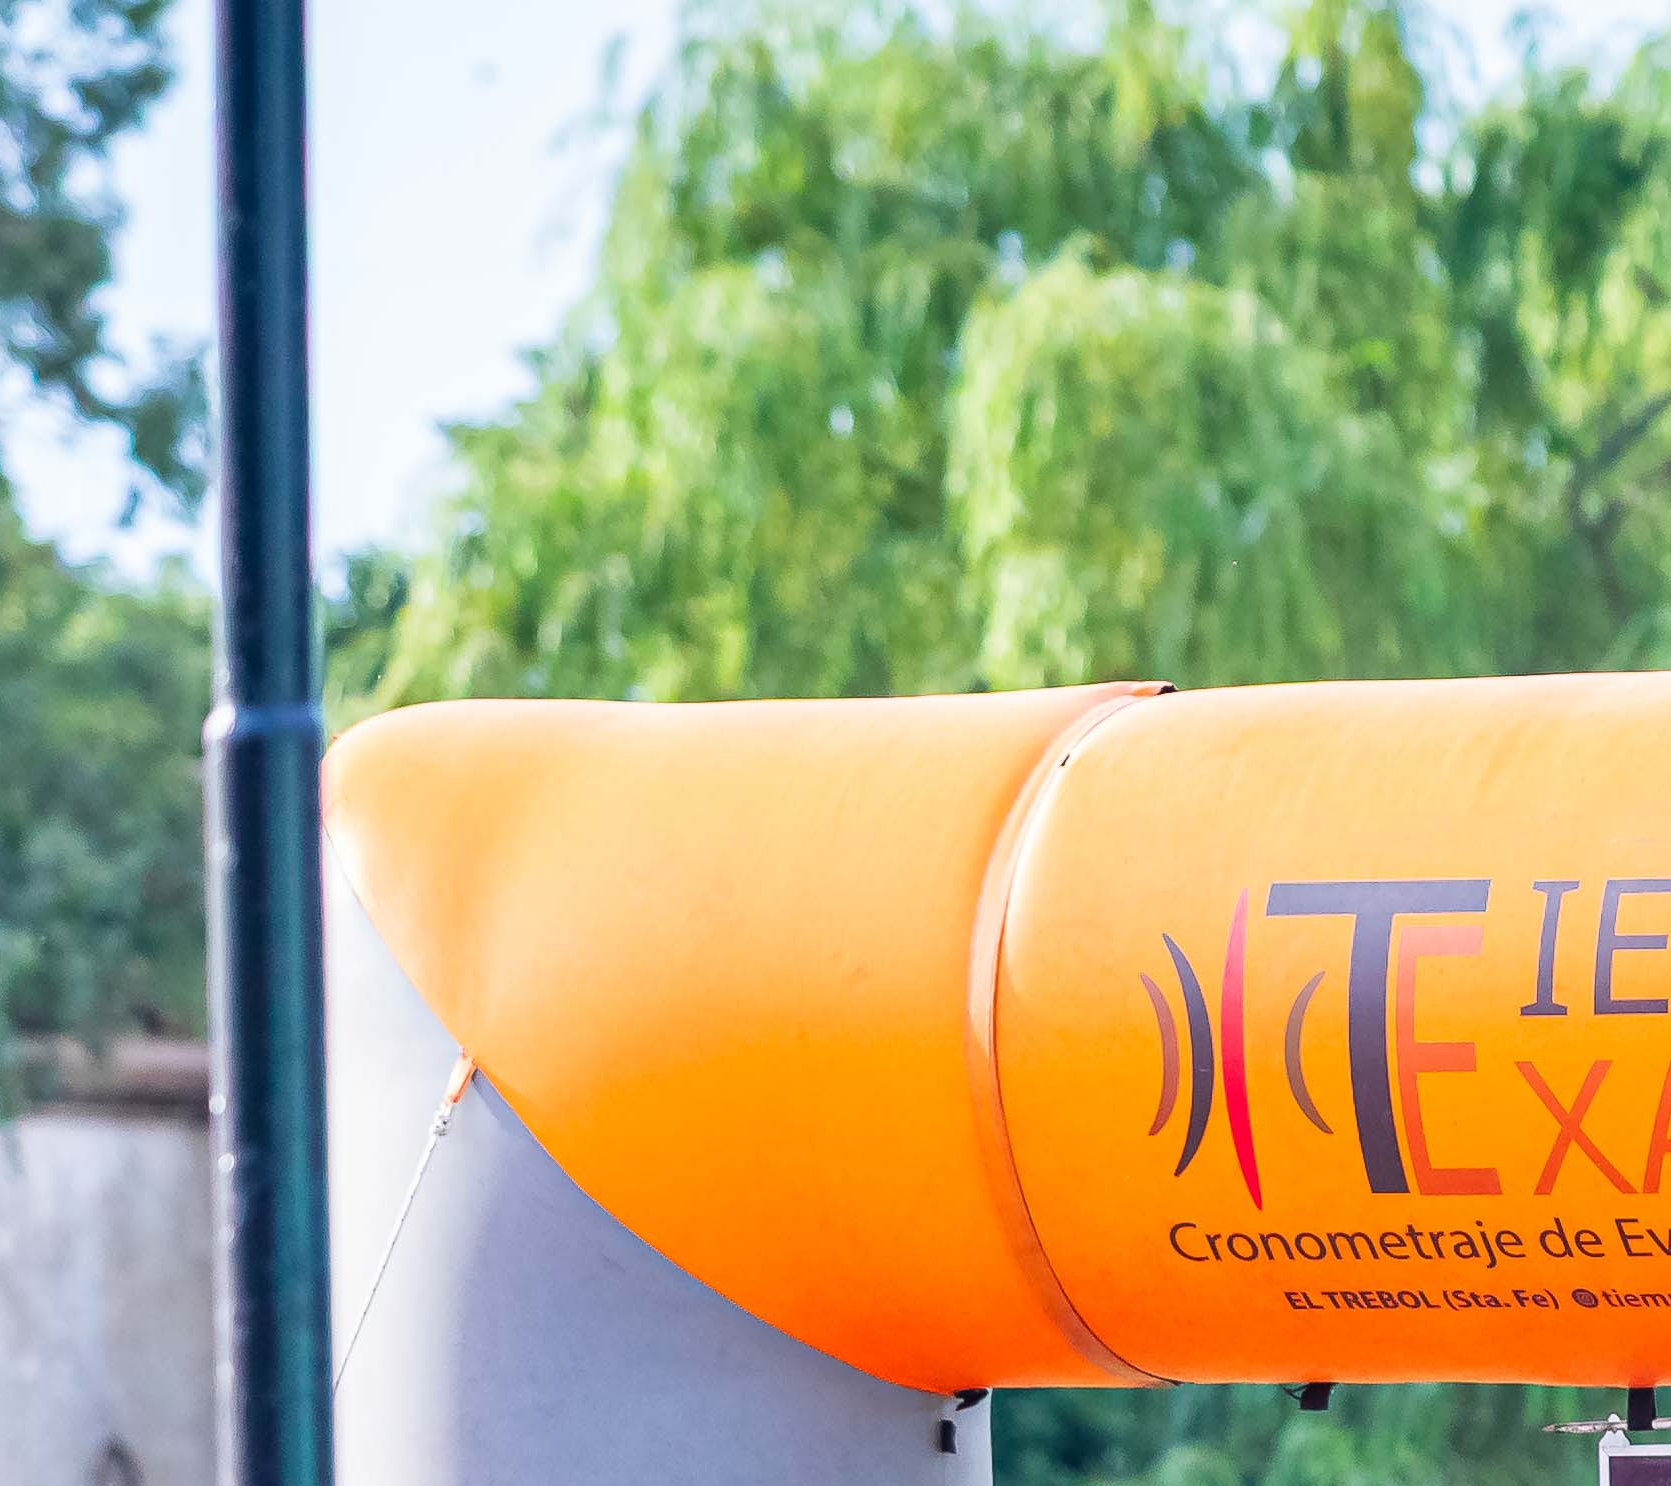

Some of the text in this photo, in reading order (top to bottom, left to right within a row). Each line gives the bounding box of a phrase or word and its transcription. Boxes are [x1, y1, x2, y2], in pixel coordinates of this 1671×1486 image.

[1168, 1221, 1527, 1268] Cronometraje
[1539, 1216, 1606, 1258] de
[1284, 1291, 1323, 1310] EL
[1322, 1290, 1441, 1310] TREBOL
[1442, 1289, 1511, 1312] (Sta.
[1515, 1289, 1560, 1310] Fe)
